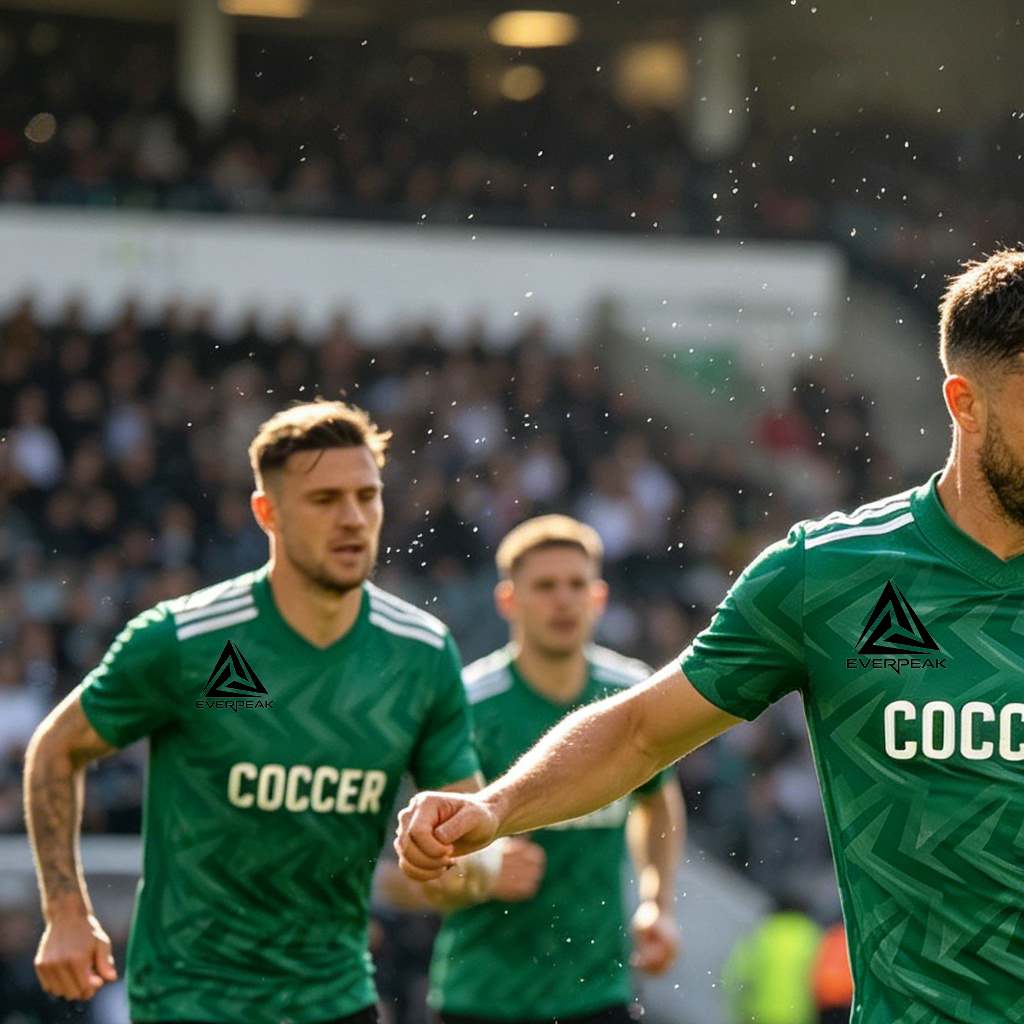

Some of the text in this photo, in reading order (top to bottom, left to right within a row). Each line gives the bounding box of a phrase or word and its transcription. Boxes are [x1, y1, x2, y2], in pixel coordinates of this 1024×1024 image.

[846, 658, 948, 675] EVERPEAK
[195, 700, 274, 714] EVERPEAK
[227, 762, 387, 814] COCCER
